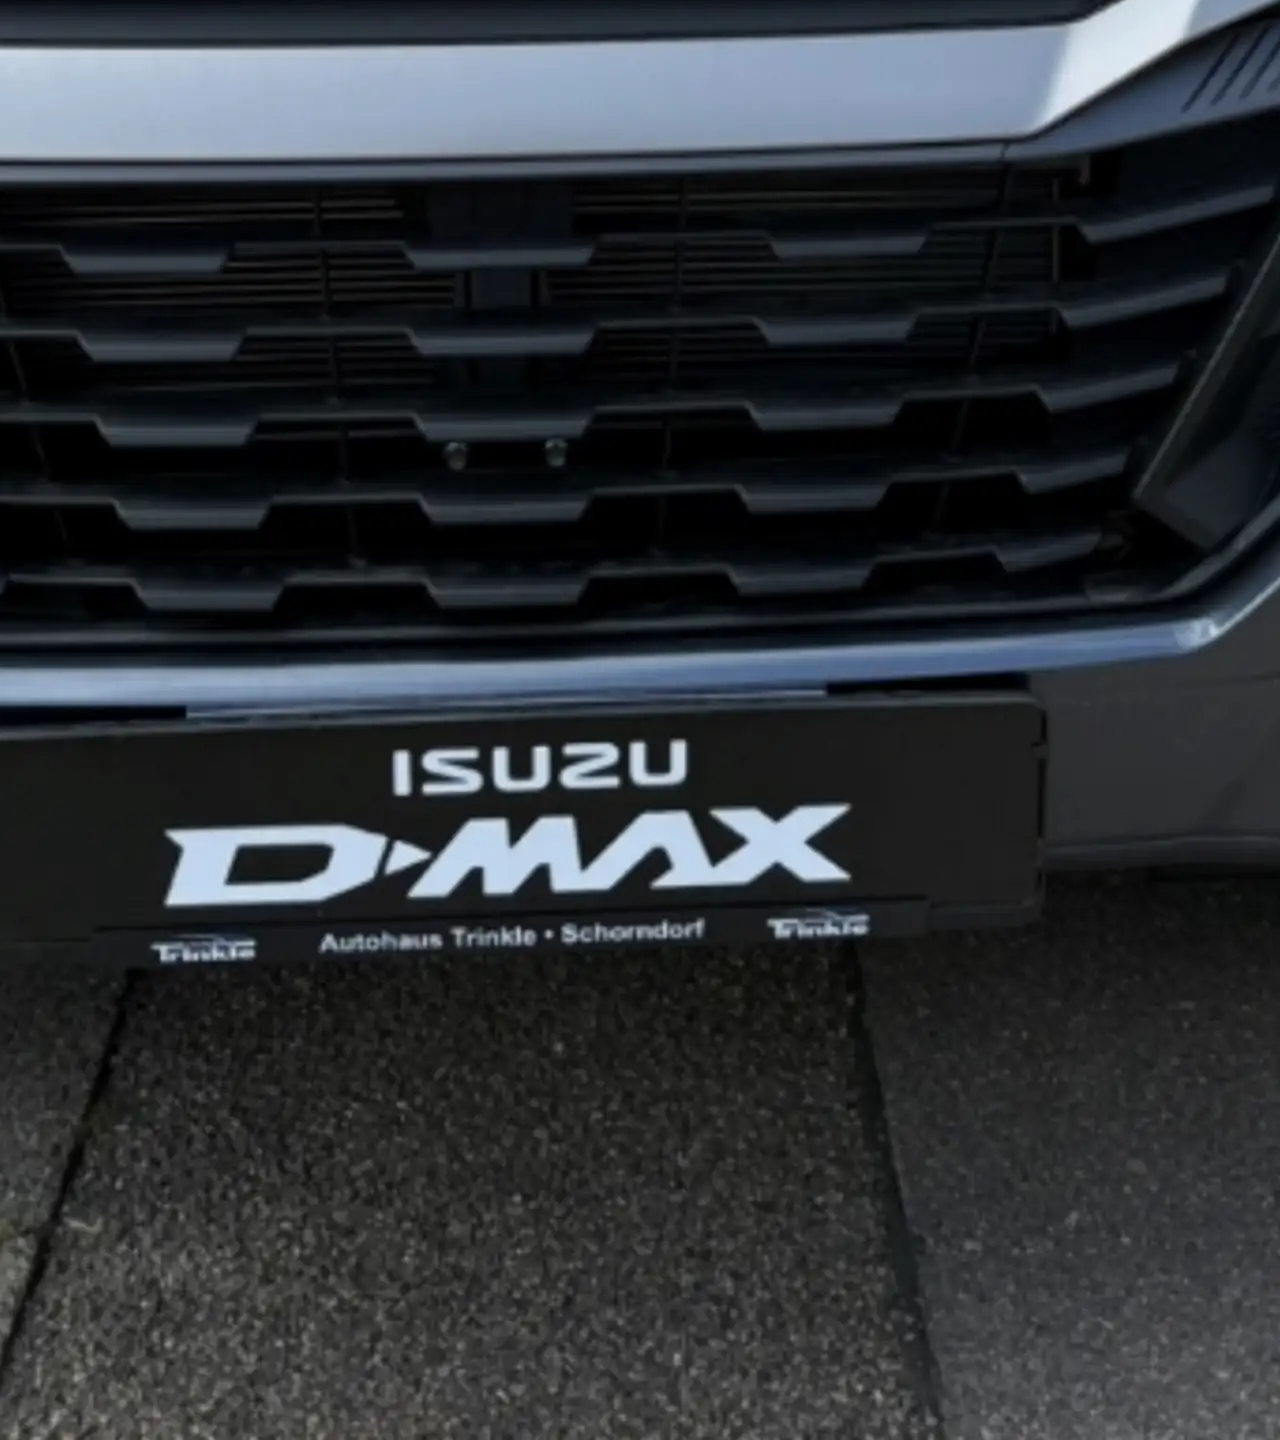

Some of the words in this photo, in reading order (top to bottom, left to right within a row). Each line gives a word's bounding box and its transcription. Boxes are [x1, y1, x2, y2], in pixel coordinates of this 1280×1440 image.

[392, 739, 688, 796] ISUZU
[320, 931, 443, 954] Autohaus
[450, 925, 537, 949] Trinkle
[561, 918, 705, 944] Schorndorf
